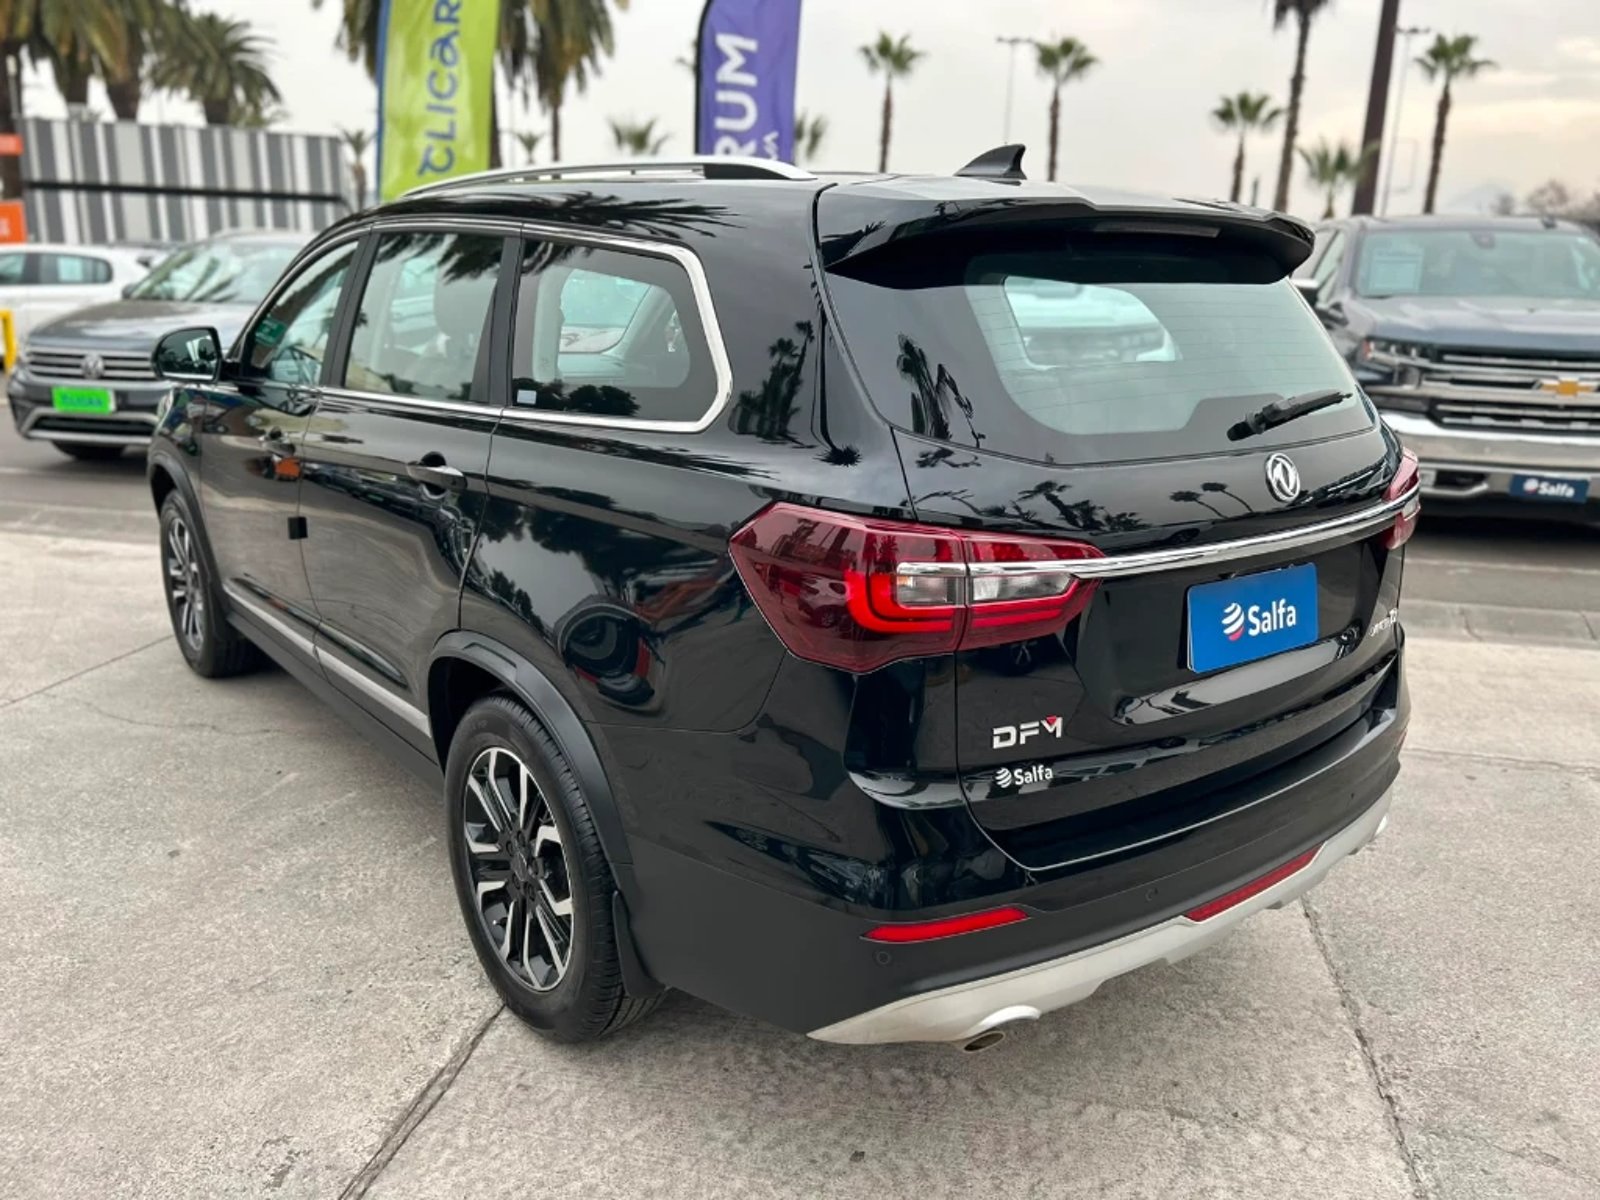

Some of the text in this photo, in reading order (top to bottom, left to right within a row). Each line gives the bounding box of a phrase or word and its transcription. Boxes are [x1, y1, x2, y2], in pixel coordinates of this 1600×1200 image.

[1538, 481, 1575, 498] Salfa
[1247, 598, 1297, 637] Salfa
[992, 715, 1063, 750] DFM
[1013, 764, 1054, 786] Salfa
